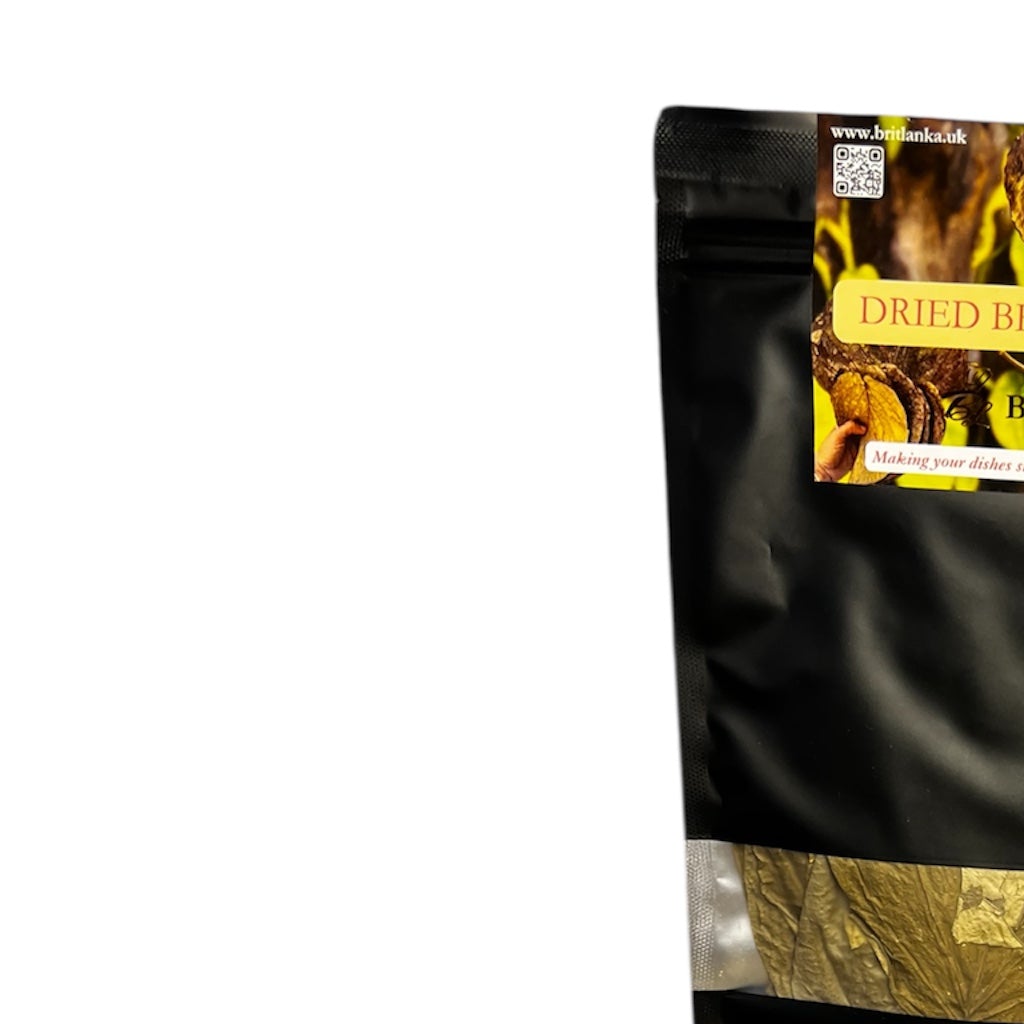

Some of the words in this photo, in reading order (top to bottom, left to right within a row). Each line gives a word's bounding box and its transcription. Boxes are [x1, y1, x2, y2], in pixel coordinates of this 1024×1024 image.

[830, 125, 967, 144] www.britlanka.uk
[859, 295, 980, 330] DRIED
[872, 450, 930, 470] Making
[931, 457, 966, 471] your
[968, 456, 1012, 472] dishes
